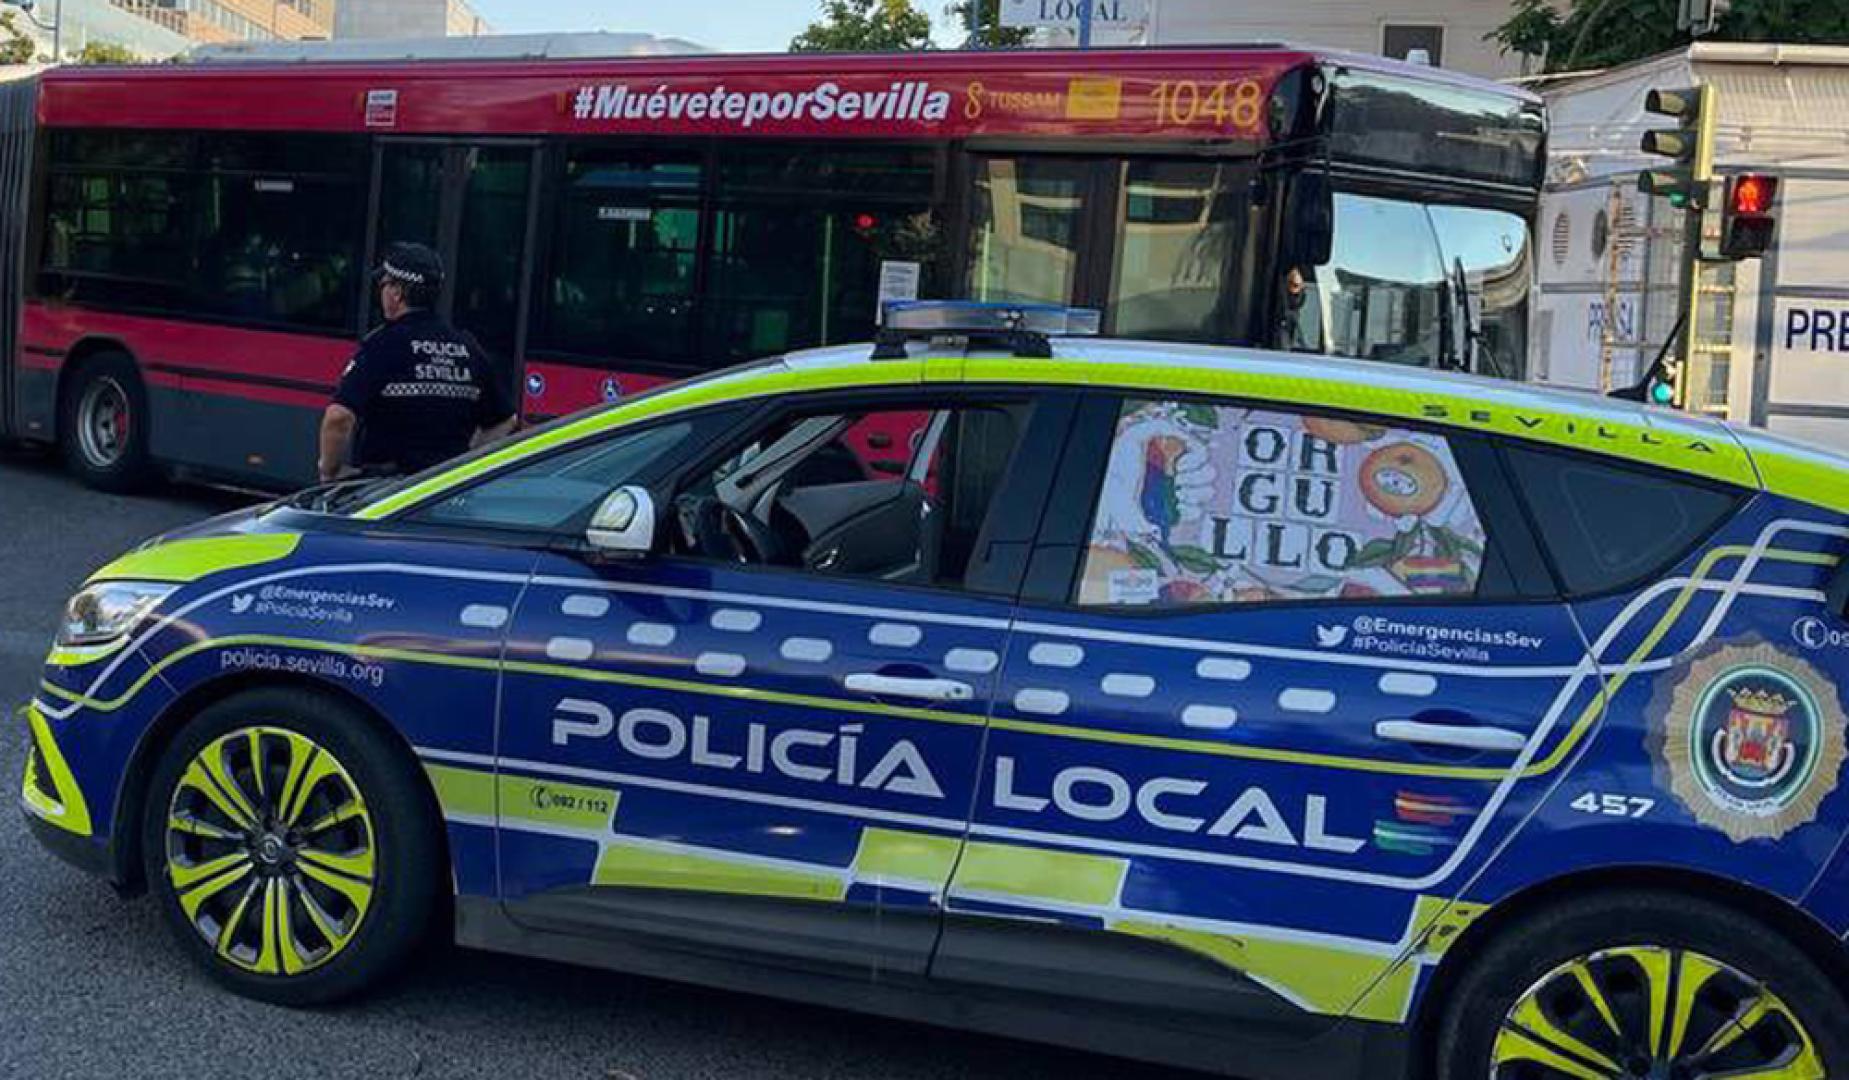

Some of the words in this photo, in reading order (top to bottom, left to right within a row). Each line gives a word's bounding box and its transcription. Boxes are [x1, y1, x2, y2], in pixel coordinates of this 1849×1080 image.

[573, 82, 950, 127] #MuéveteporSevilla
[1151, 80, 1262, 128] 1048
[415, 364, 472, 382] SEVILLA
[1424, 404, 1714, 454] SEVILLA
[1238, 473, 1334, 519] GU
[1211, 517, 1357, 571] LLO
[259, 584, 395, 609] @EmergenciasSev
[1352, 615, 1543, 649] @EmergenciasSev
[220, 648, 384, 687] policia.sevilla.org
[552, 697, 946, 798] POLICÍA
[993, 755, 1367, 854] LOCAL
[1570, 791, 1654, 818] 457
